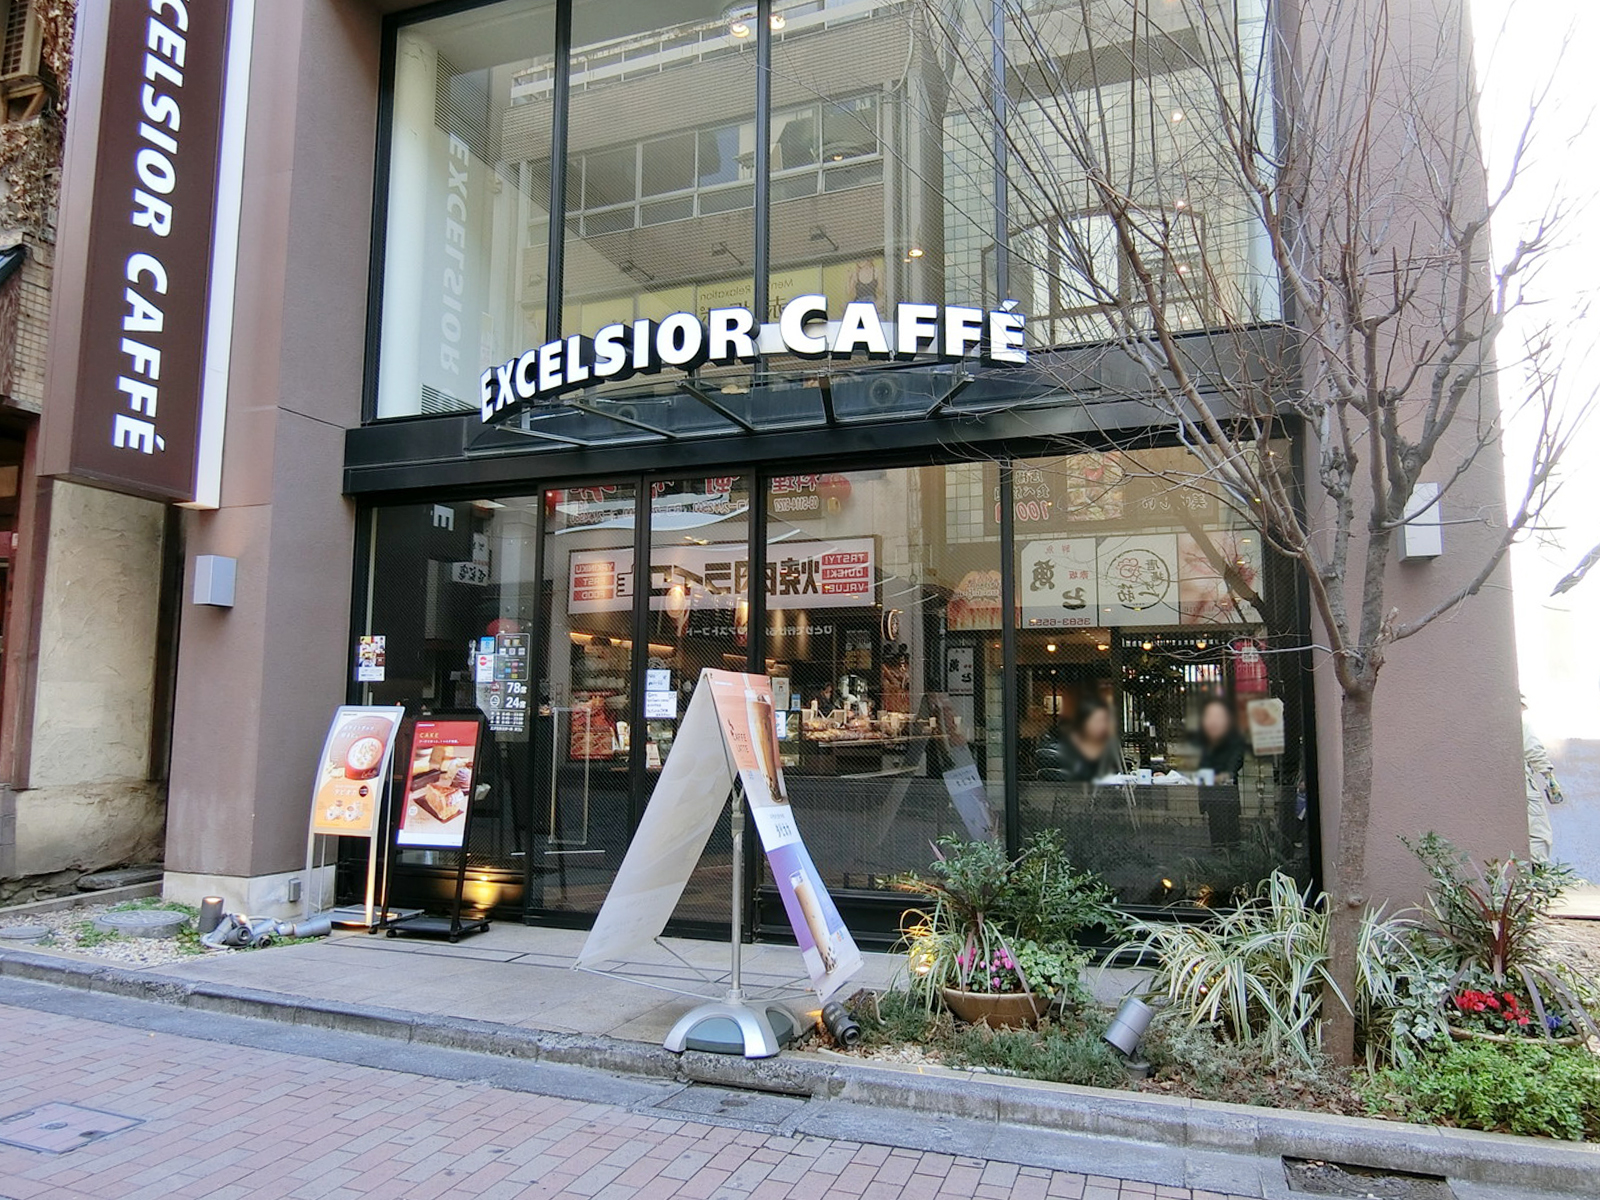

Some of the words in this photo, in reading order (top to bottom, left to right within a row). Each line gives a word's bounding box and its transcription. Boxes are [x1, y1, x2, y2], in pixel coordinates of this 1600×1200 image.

[130, 0, 189, 238] CELSIOR
[113, 253, 168, 456] CAFFÉ
[480, 307, 757, 423] EXCELSIOR
[780, 294, 1028, 364] CAFFÉ
